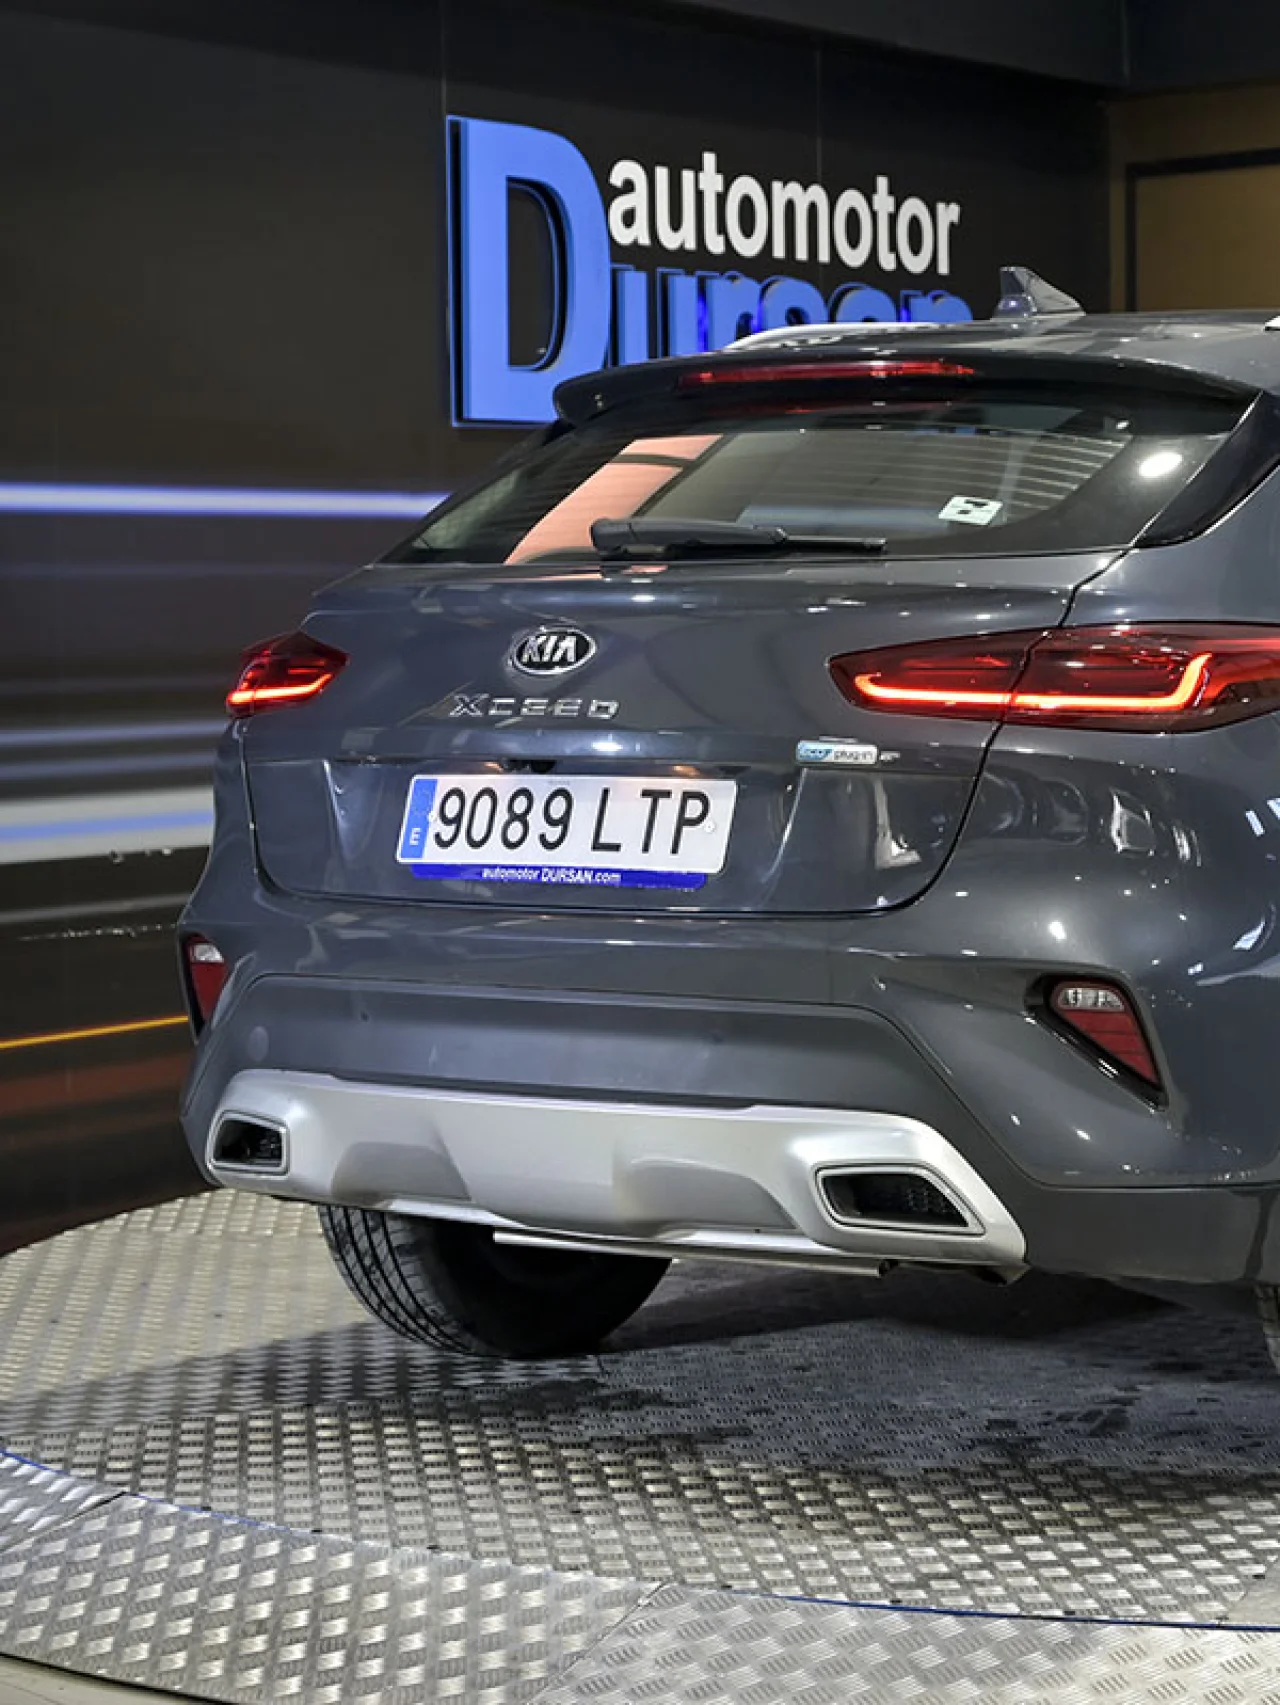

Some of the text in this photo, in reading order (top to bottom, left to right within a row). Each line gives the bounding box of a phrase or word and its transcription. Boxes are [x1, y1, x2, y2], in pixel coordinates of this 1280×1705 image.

[607, 151, 961, 276] automotor
[521, 636, 577, 663] KIA
[449, 692, 620, 720] XCEED
[434, 786, 711, 855] 9089 LTP
[409, 827, 423, 846] E
[481, 866, 541, 881] automotor
